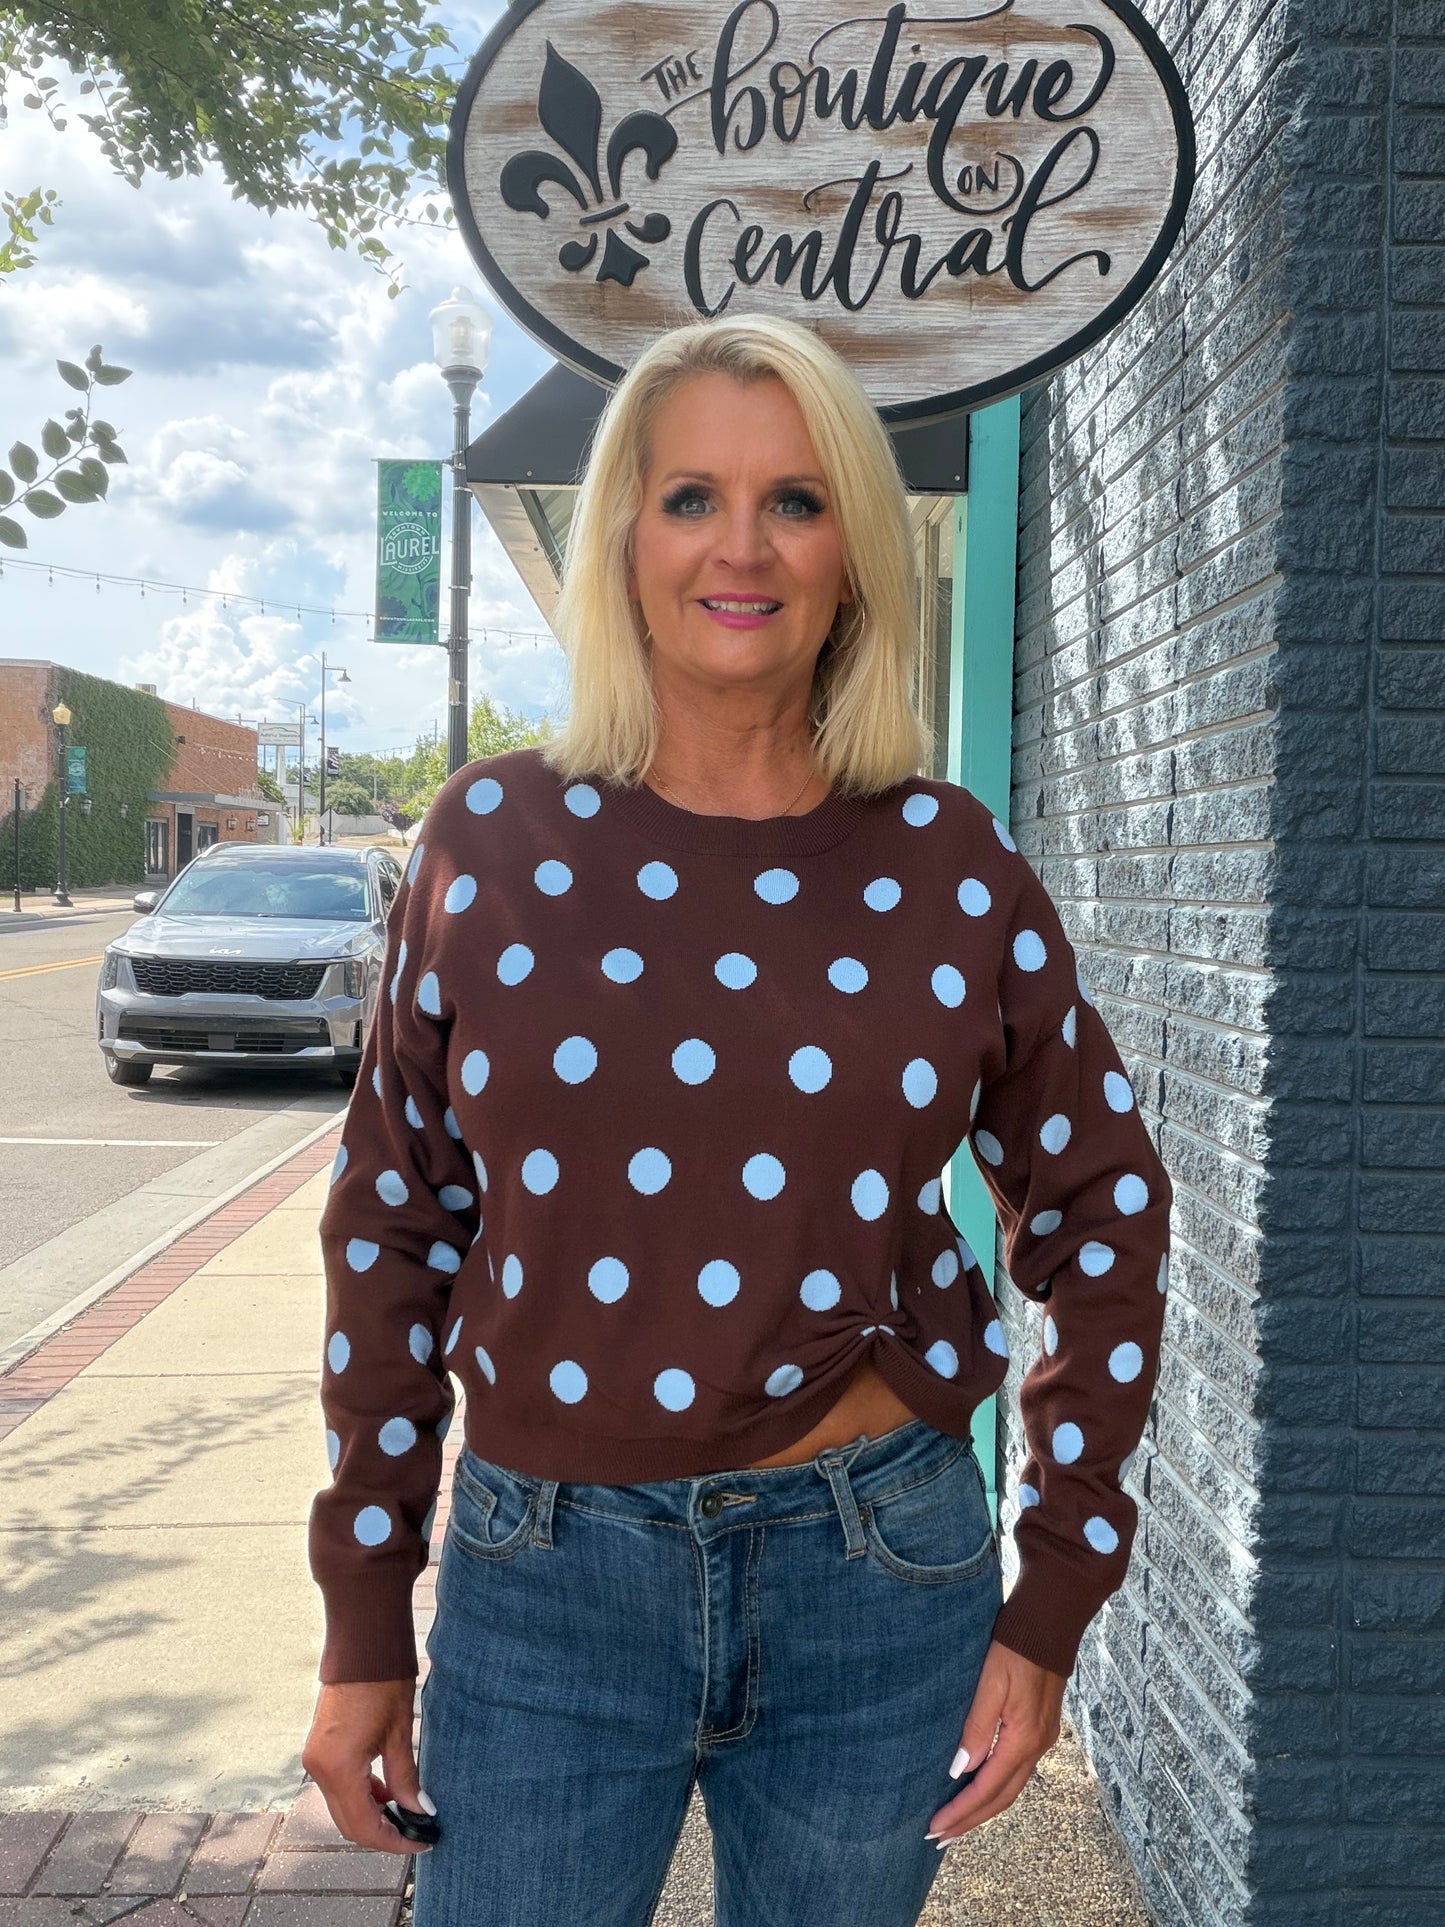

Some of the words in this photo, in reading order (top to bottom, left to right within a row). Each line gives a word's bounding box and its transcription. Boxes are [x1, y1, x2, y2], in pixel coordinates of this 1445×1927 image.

[641, 50, 702, 100] THE
[663, 0, 1115, 212] boutique
[957, 160, 999, 194] ON
[684, 126, 1111, 316] Central
[380, 535, 440, 566] LAUREL
